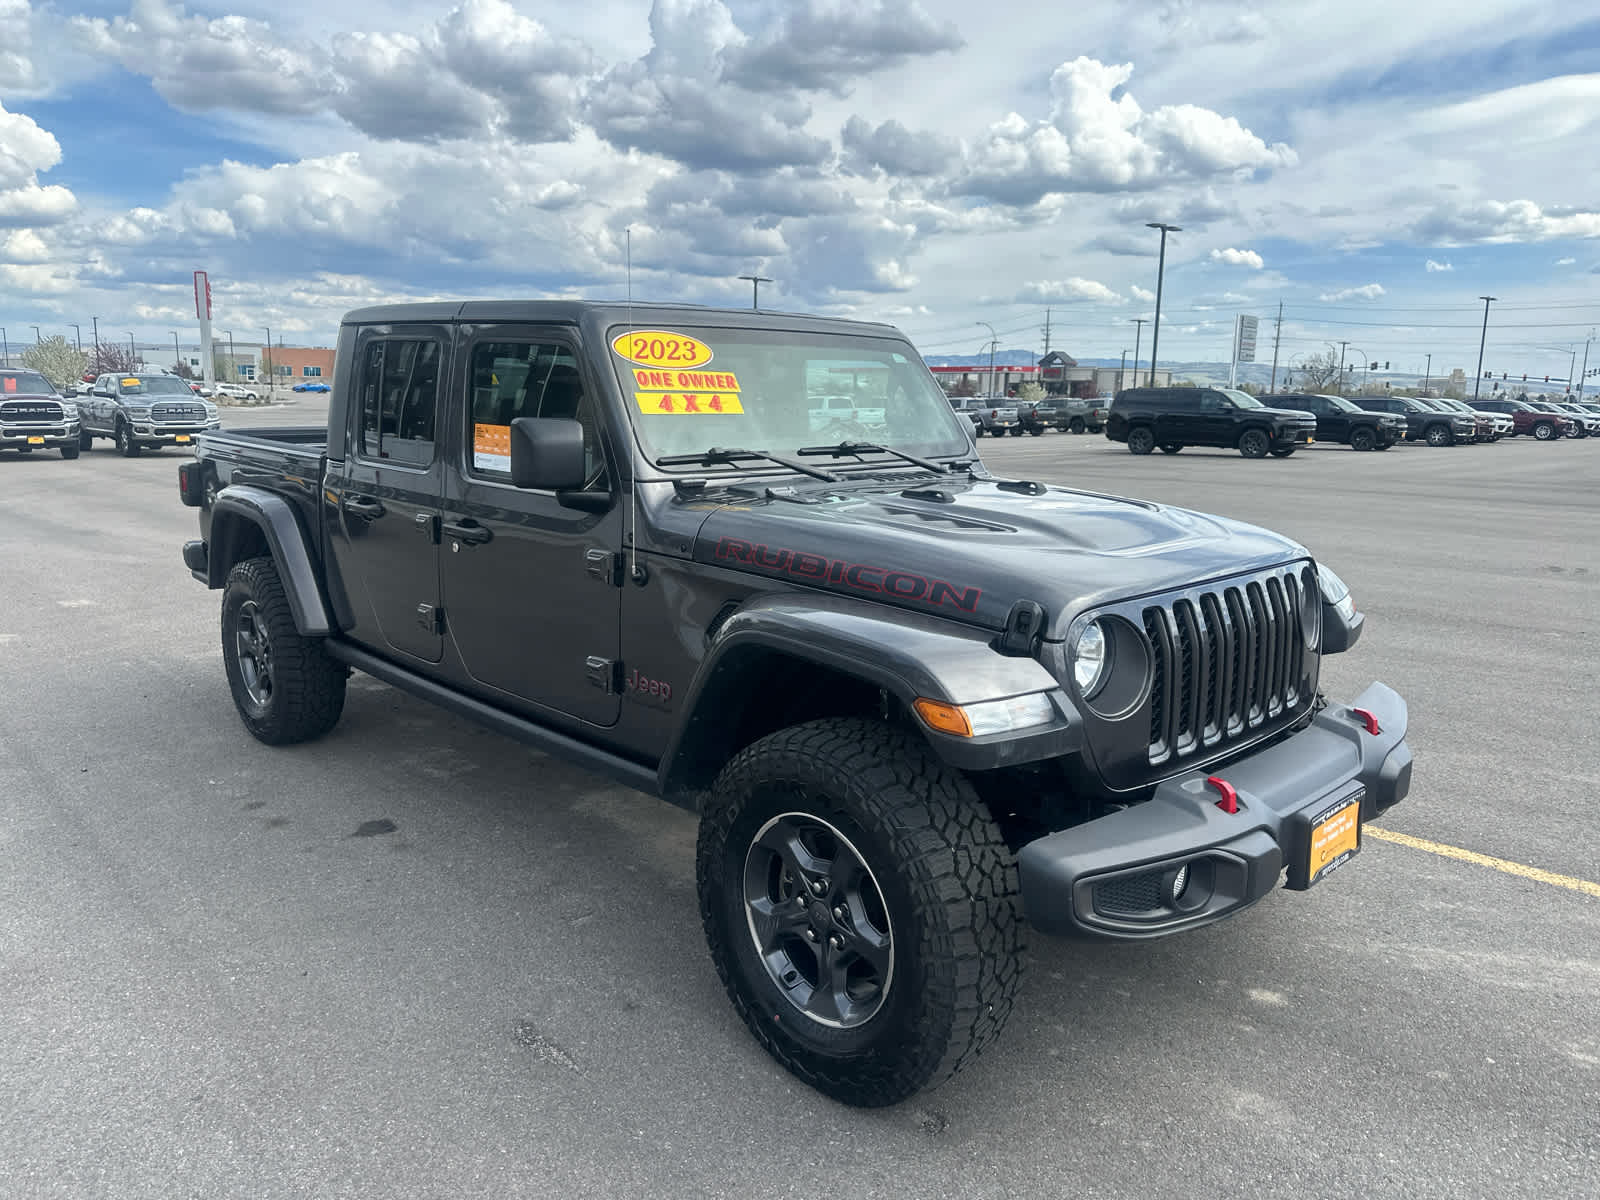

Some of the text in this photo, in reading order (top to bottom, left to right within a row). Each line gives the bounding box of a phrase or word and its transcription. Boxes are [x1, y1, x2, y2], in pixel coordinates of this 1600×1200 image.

[633, 338, 697, 361] 2023
[636, 370, 738, 390] ONE OWNER
[658, 394, 724, 413] 4 X 4
[715, 535, 983, 613] RUBICON
[624, 668, 673, 705] Jeep
